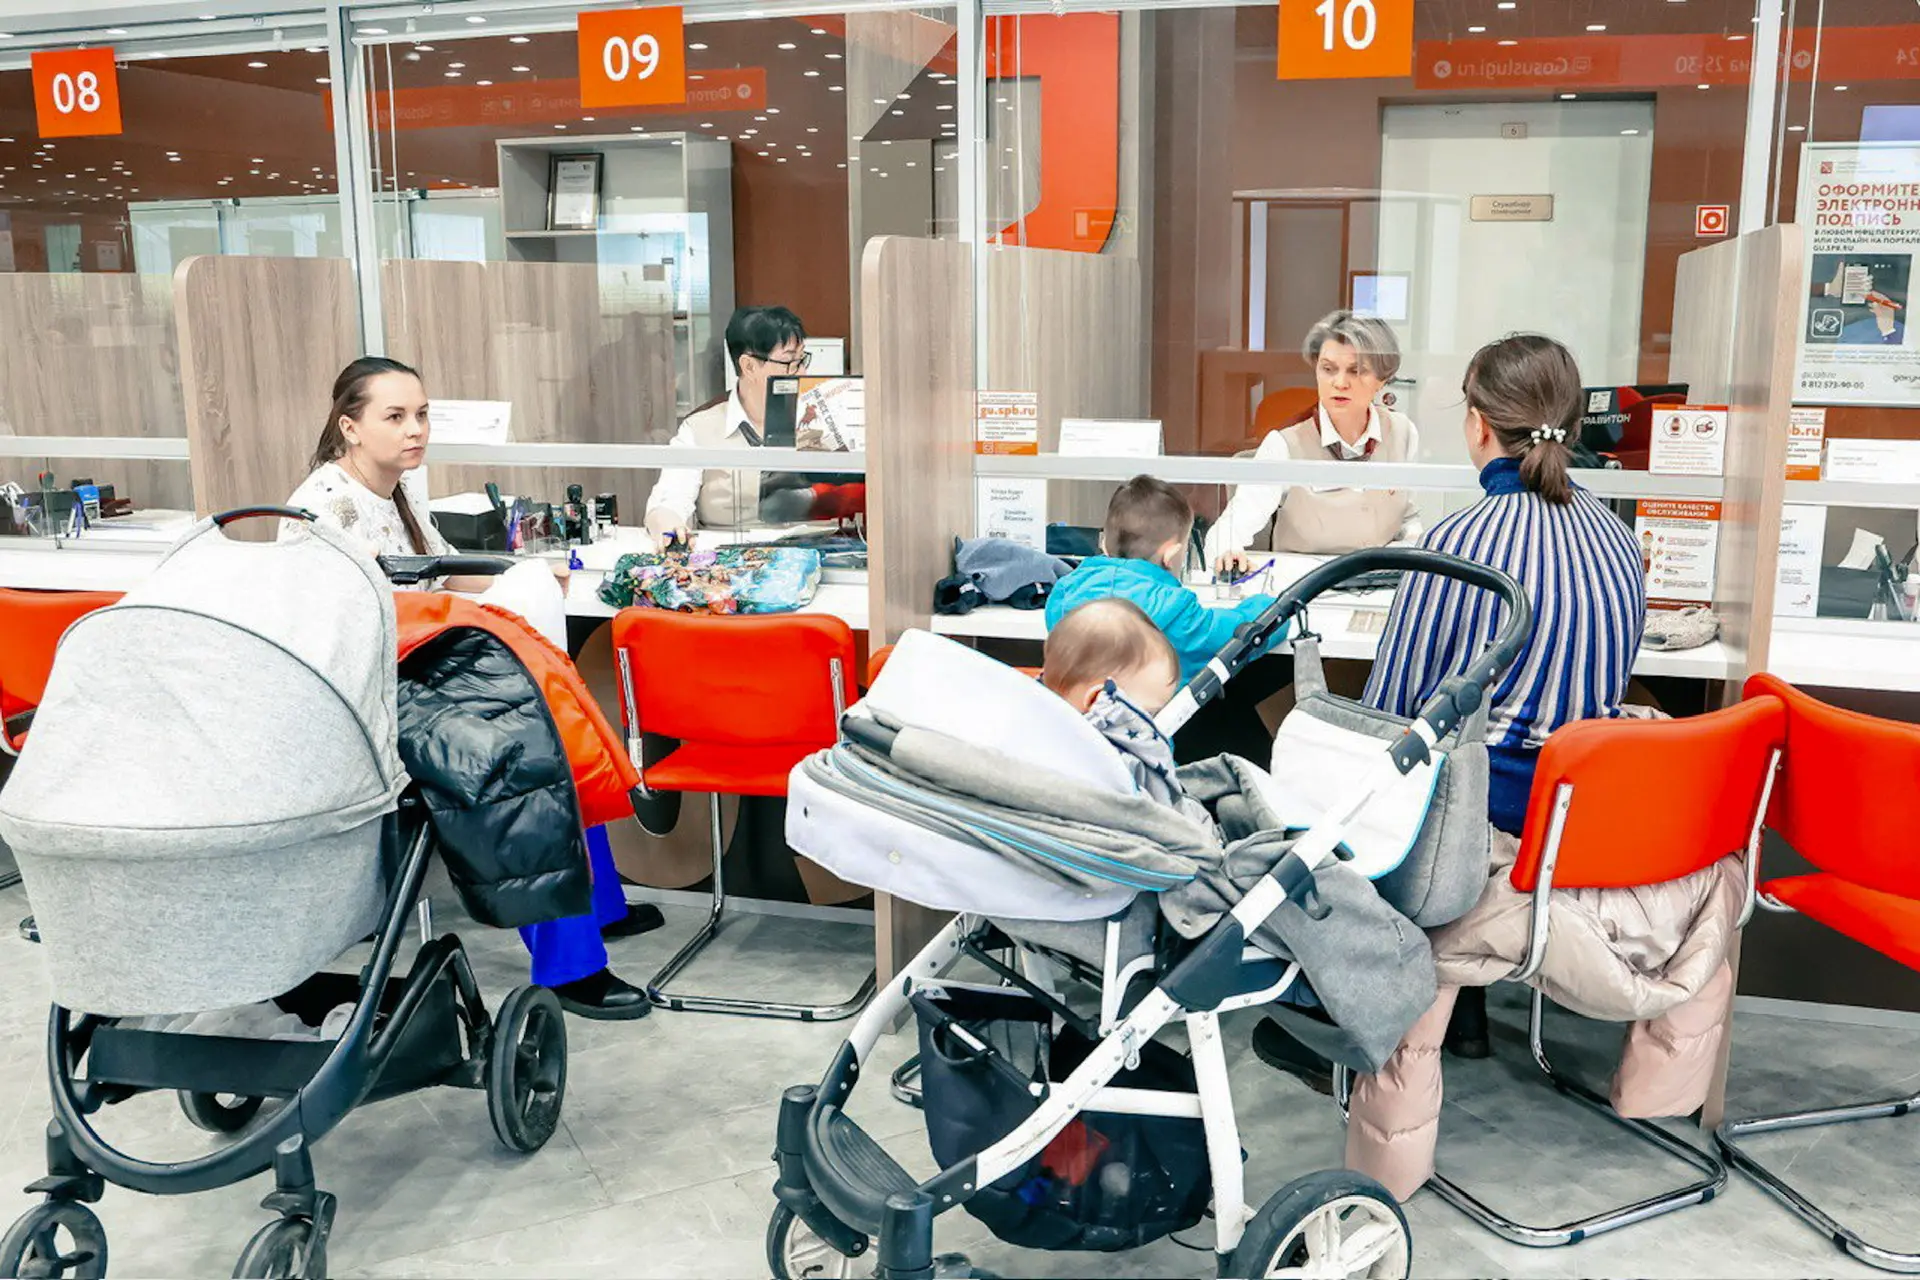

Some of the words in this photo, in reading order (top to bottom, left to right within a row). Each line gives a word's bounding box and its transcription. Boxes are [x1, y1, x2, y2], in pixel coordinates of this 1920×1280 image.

[1315, 0, 1376, 50] 10
[603, 34, 659, 81] 09
[53, 71, 100, 114] 08
[1818, 183, 1919, 197] ОФОРМИТЕ
[1816, 213, 1902, 227] ПОДПИСЬ
[980, 404, 1035, 418] gu.spb.ru
[1642, 501, 1676, 509] ОЦЕНИТЕ
[1678, 503, 1715, 511] КАЧЕСТВО
